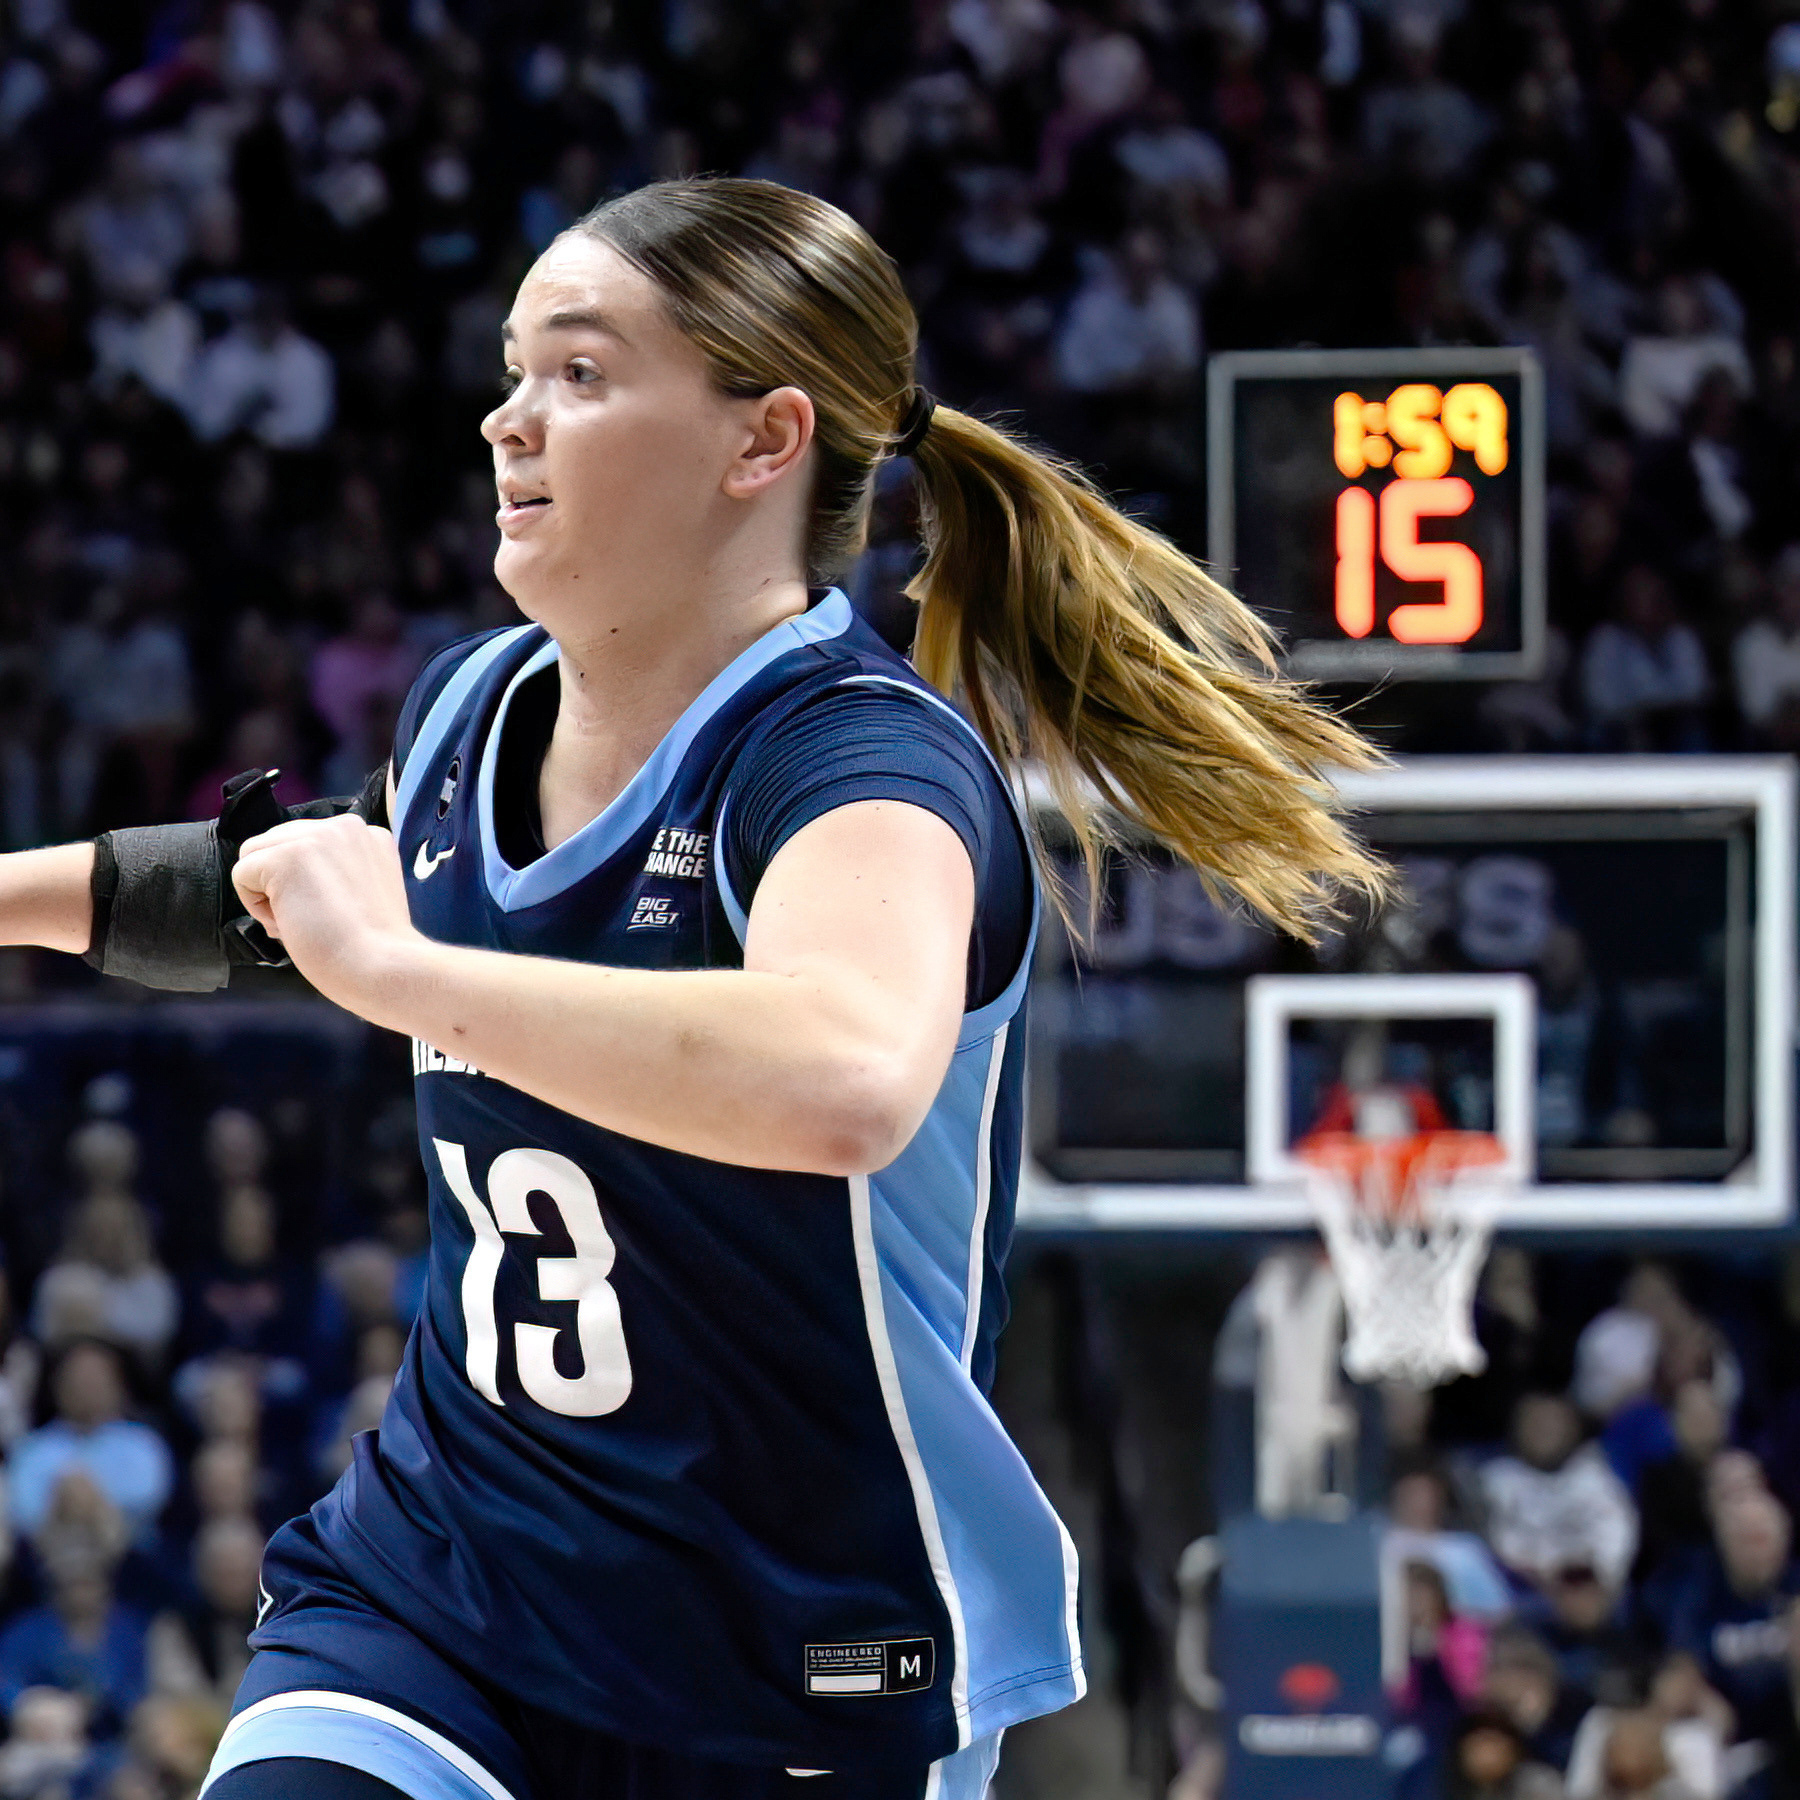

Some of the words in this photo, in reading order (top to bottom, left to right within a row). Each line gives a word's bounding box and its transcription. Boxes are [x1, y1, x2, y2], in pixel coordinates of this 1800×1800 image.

[1332, 382, 1509, 480] 1:59
[1334, 477, 1484, 645] 15
[668, 831, 711, 855] THE
[643, 851, 708, 878] HANGE
[631, 911, 680, 925] EAST
[636, 896, 675, 912] BIG
[433, 1136, 633, 1418] 13
[809, 1647, 882, 1658] ENGINEERED
[899, 1654, 921, 1680] M
